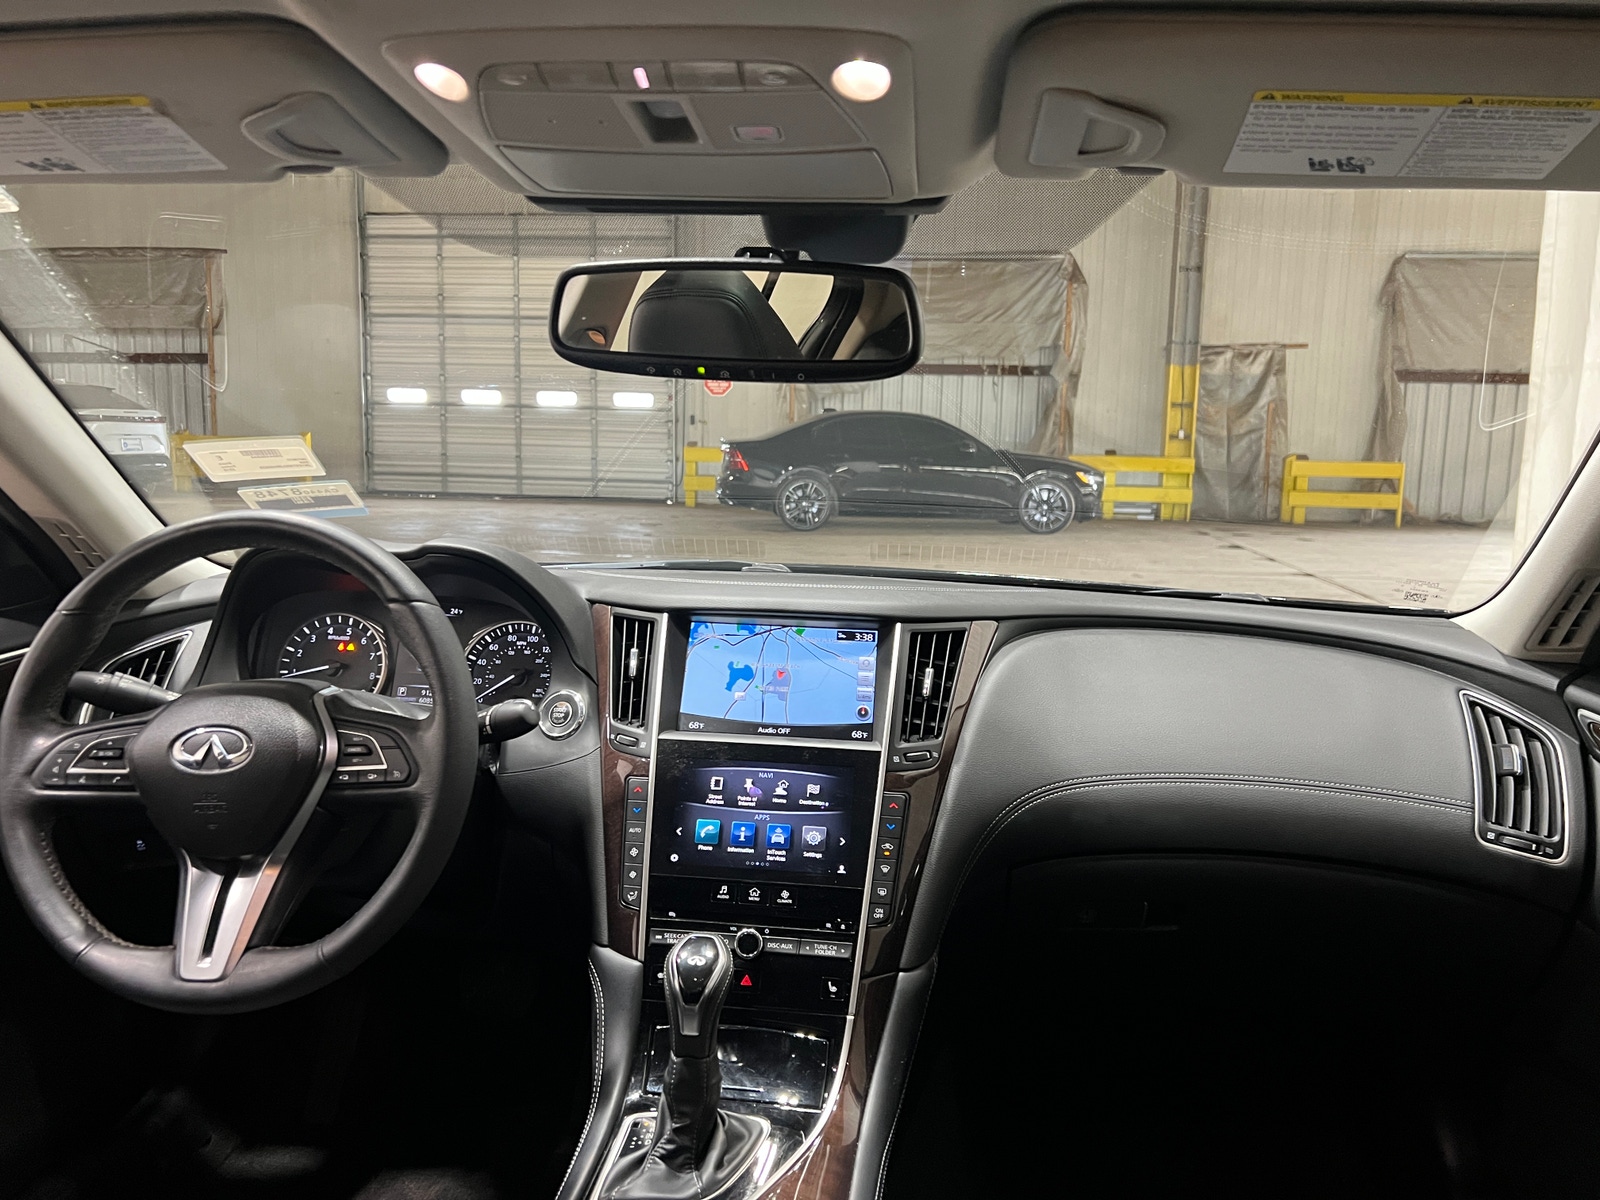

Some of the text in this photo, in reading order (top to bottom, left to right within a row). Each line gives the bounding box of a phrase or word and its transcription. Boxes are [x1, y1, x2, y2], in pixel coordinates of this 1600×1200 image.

[327, 626, 334, 634] 4
[346, 627, 352, 635] 5
[310, 634, 316, 643] 3
[361, 637, 367, 645] 6
[854, 633, 874, 642] 3:38
[297, 649, 303, 657] 2
